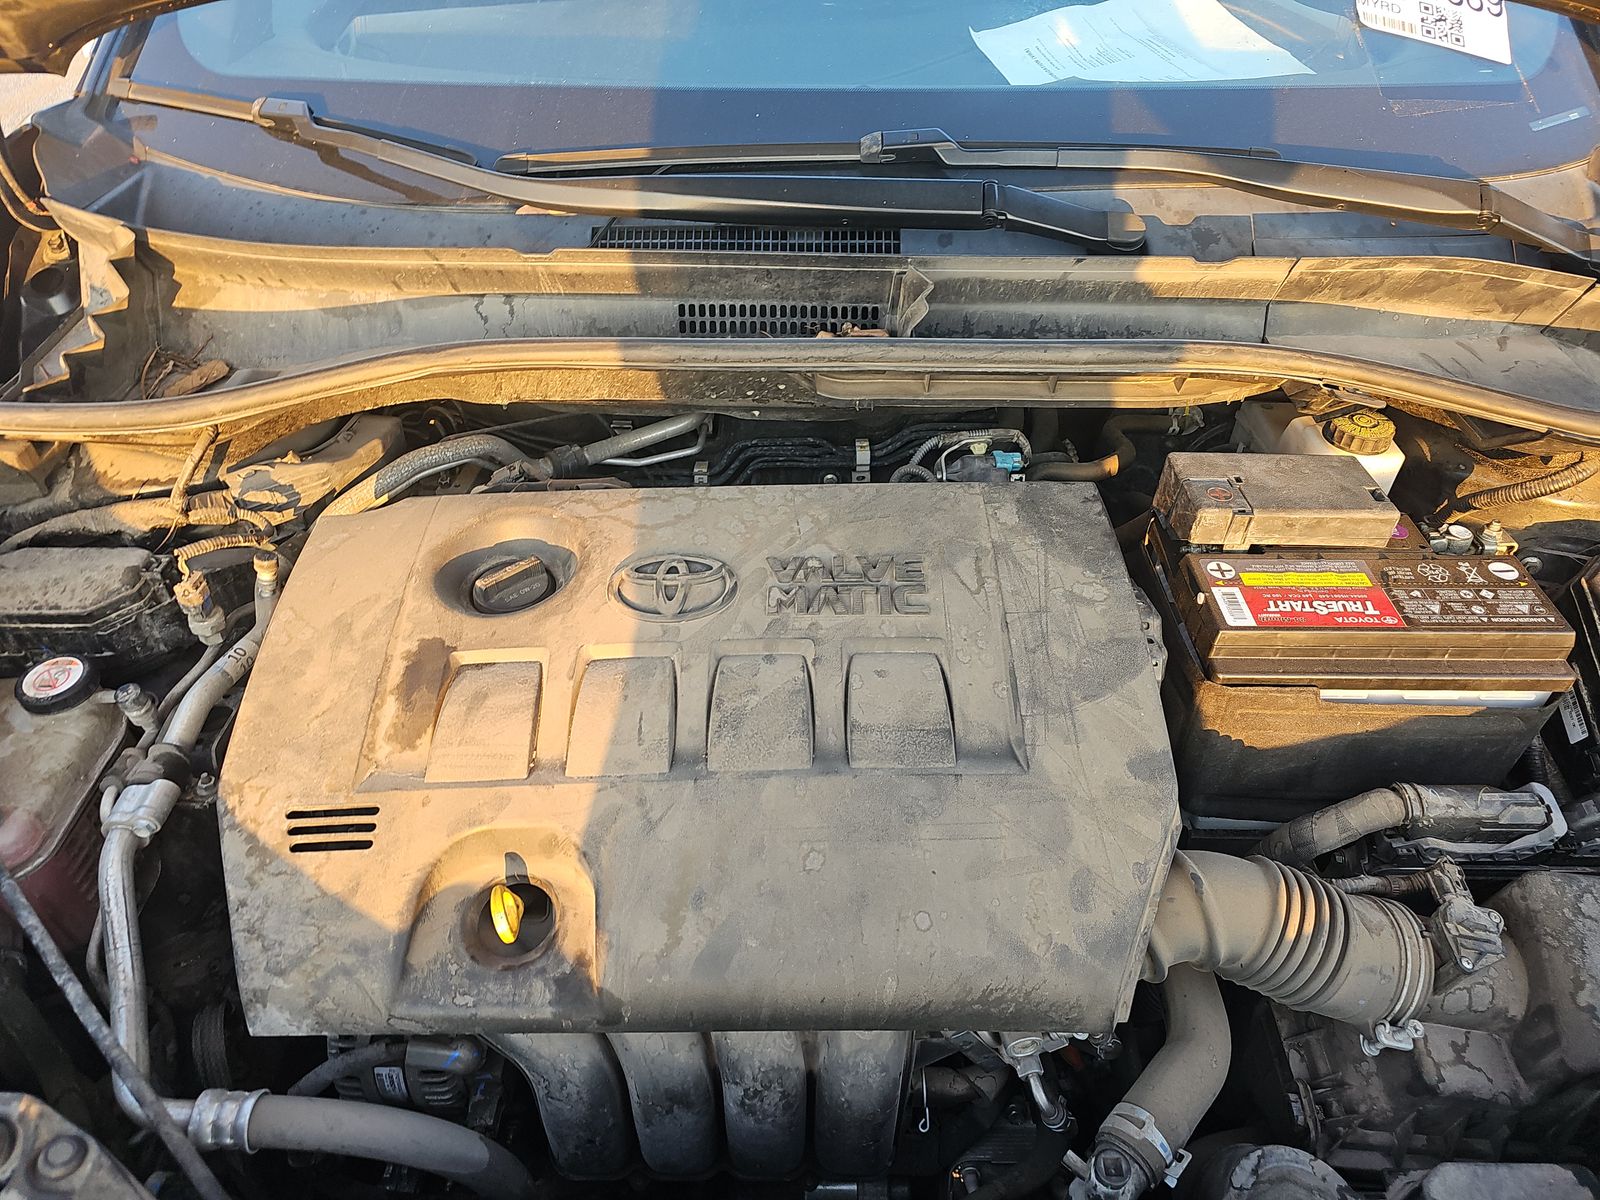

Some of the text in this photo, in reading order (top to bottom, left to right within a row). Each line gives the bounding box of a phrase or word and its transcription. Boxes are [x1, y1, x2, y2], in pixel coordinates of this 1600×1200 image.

[765, 555, 926, 584] VALVE
[505, 582, 541, 603] SAE 0W-20
[765, 584, 932, 616] MATIC
[227, 647, 247, 664] 10
